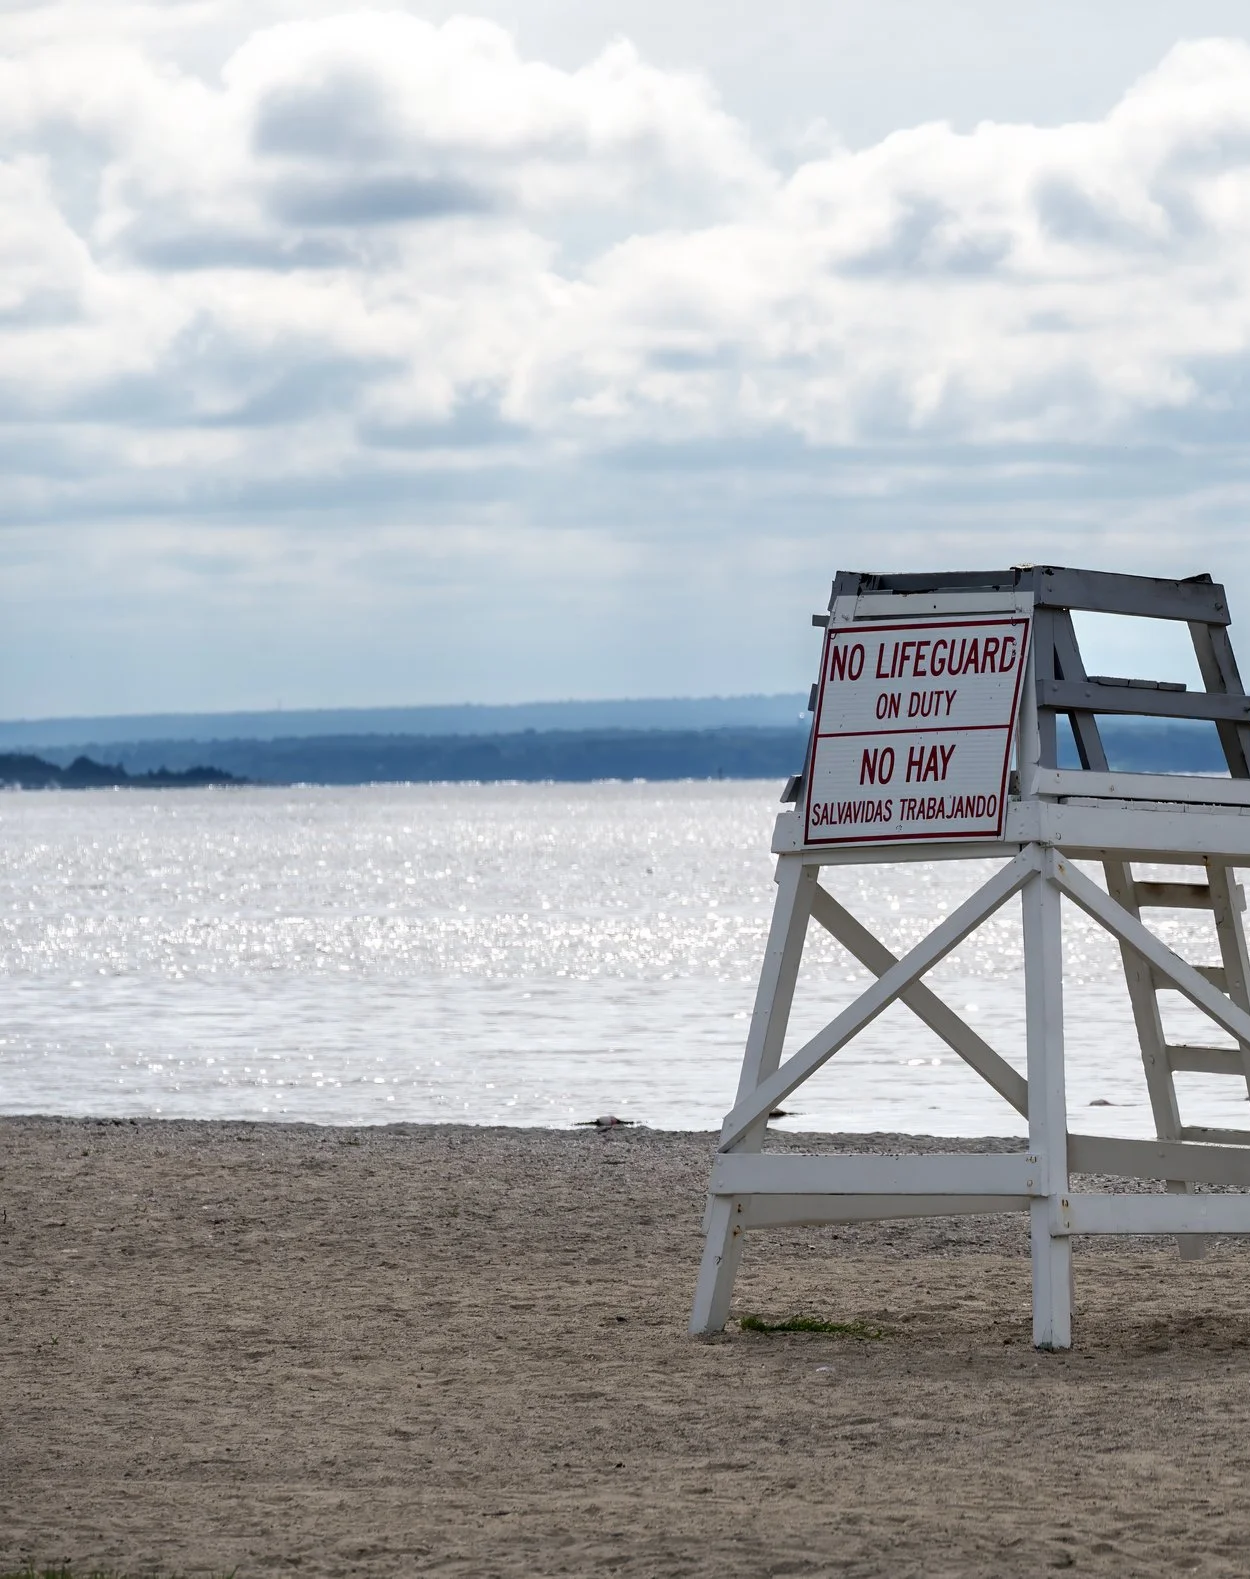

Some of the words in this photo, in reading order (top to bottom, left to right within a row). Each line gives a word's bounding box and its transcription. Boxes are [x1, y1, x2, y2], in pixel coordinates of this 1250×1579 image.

[830, 644, 865, 682] NO
[875, 636, 1017, 679] LIFEGUARD
[876, 692, 901, 719] ON
[908, 690, 957, 717] DUTY
[860, 746, 895, 785] NO
[906, 744, 956, 783] HAY
[811, 798, 893, 826] SALVAVIDAS
[900, 794, 997, 822] TRABAJANDO
